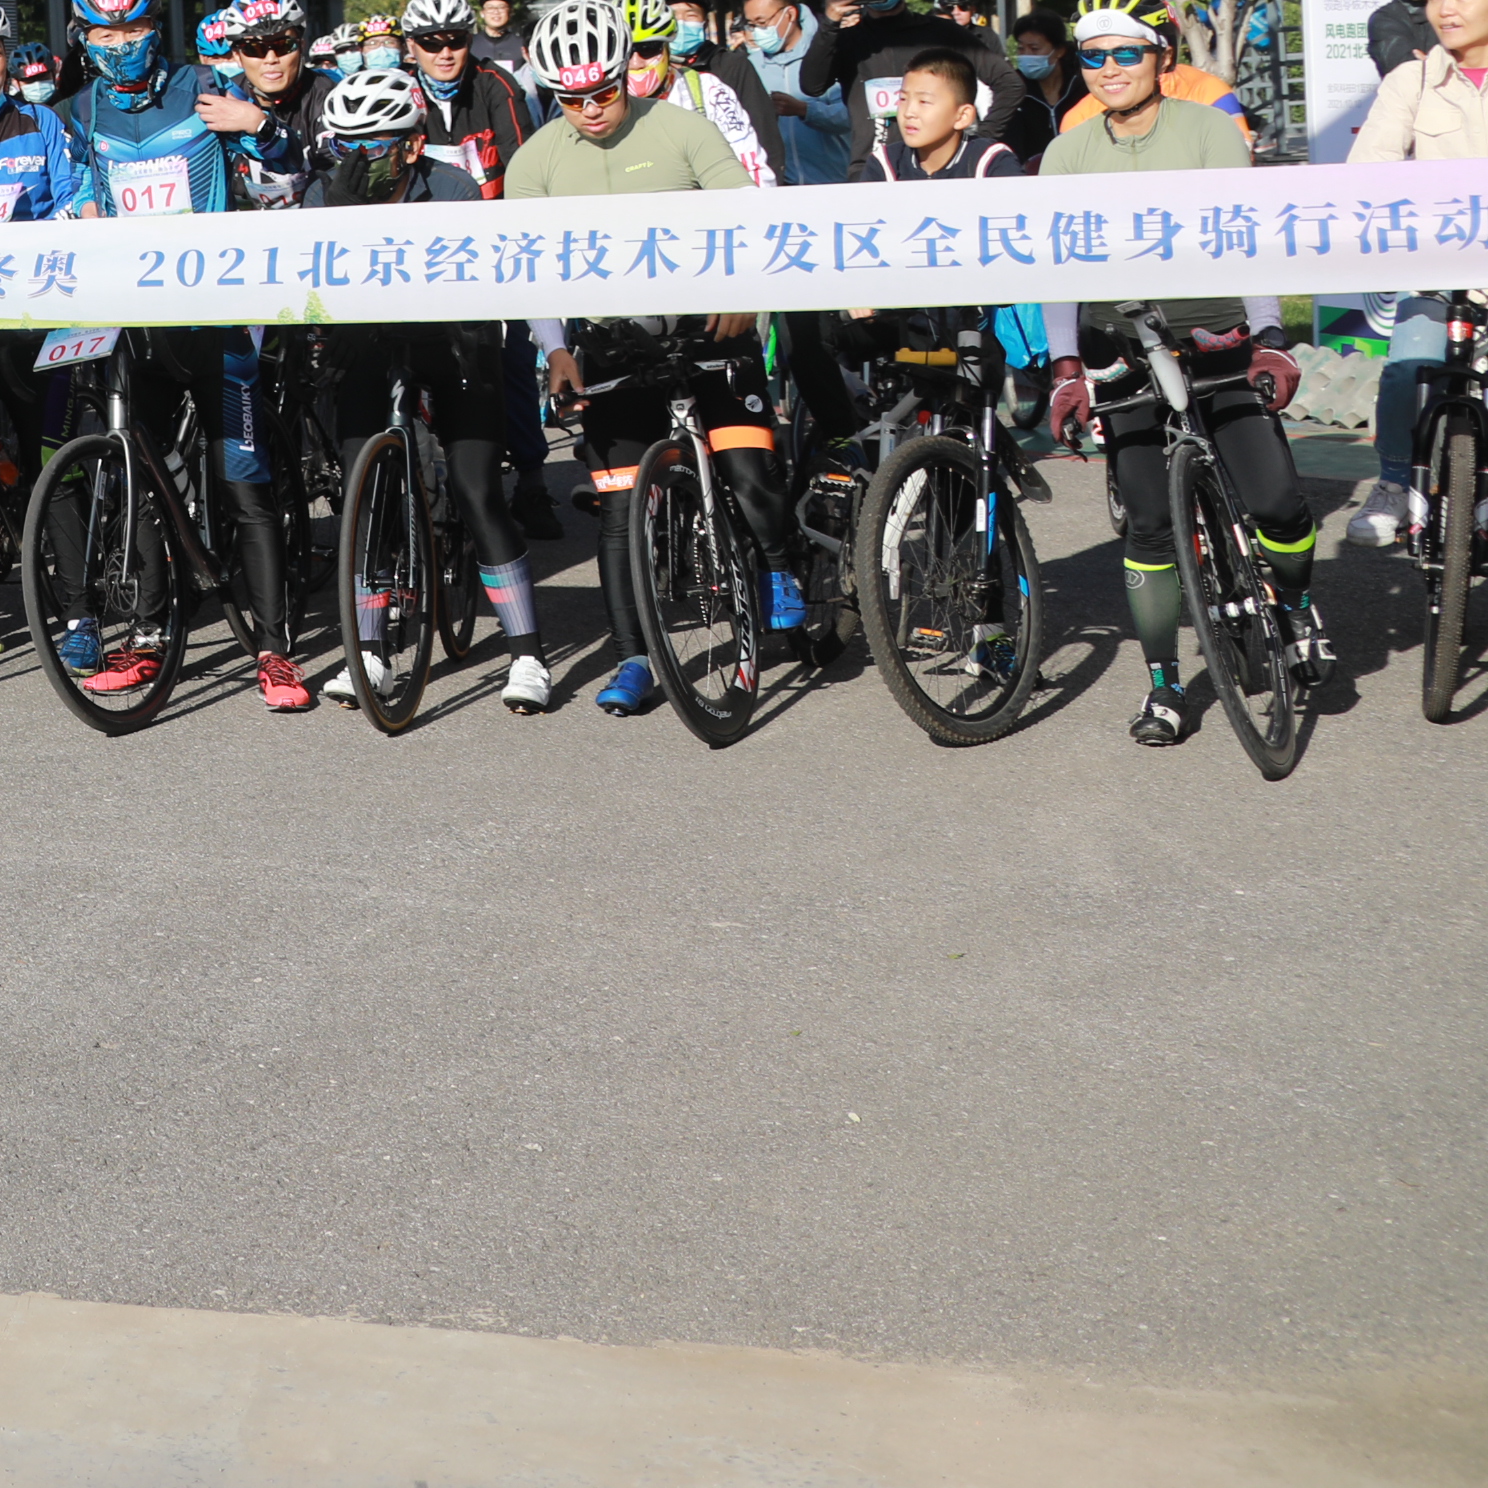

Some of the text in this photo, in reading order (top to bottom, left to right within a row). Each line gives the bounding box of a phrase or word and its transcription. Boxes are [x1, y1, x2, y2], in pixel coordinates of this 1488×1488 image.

[246, 3, 275, 19] 019
[204, 24, 225, 40] 04
[562, 67, 600, 87] 046
[121, 182, 176, 212] 017
[137, 194, 1488, 290] 2021北京经济技术开发区全民健身骑行活动
[48, 336, 107, 362] 017
